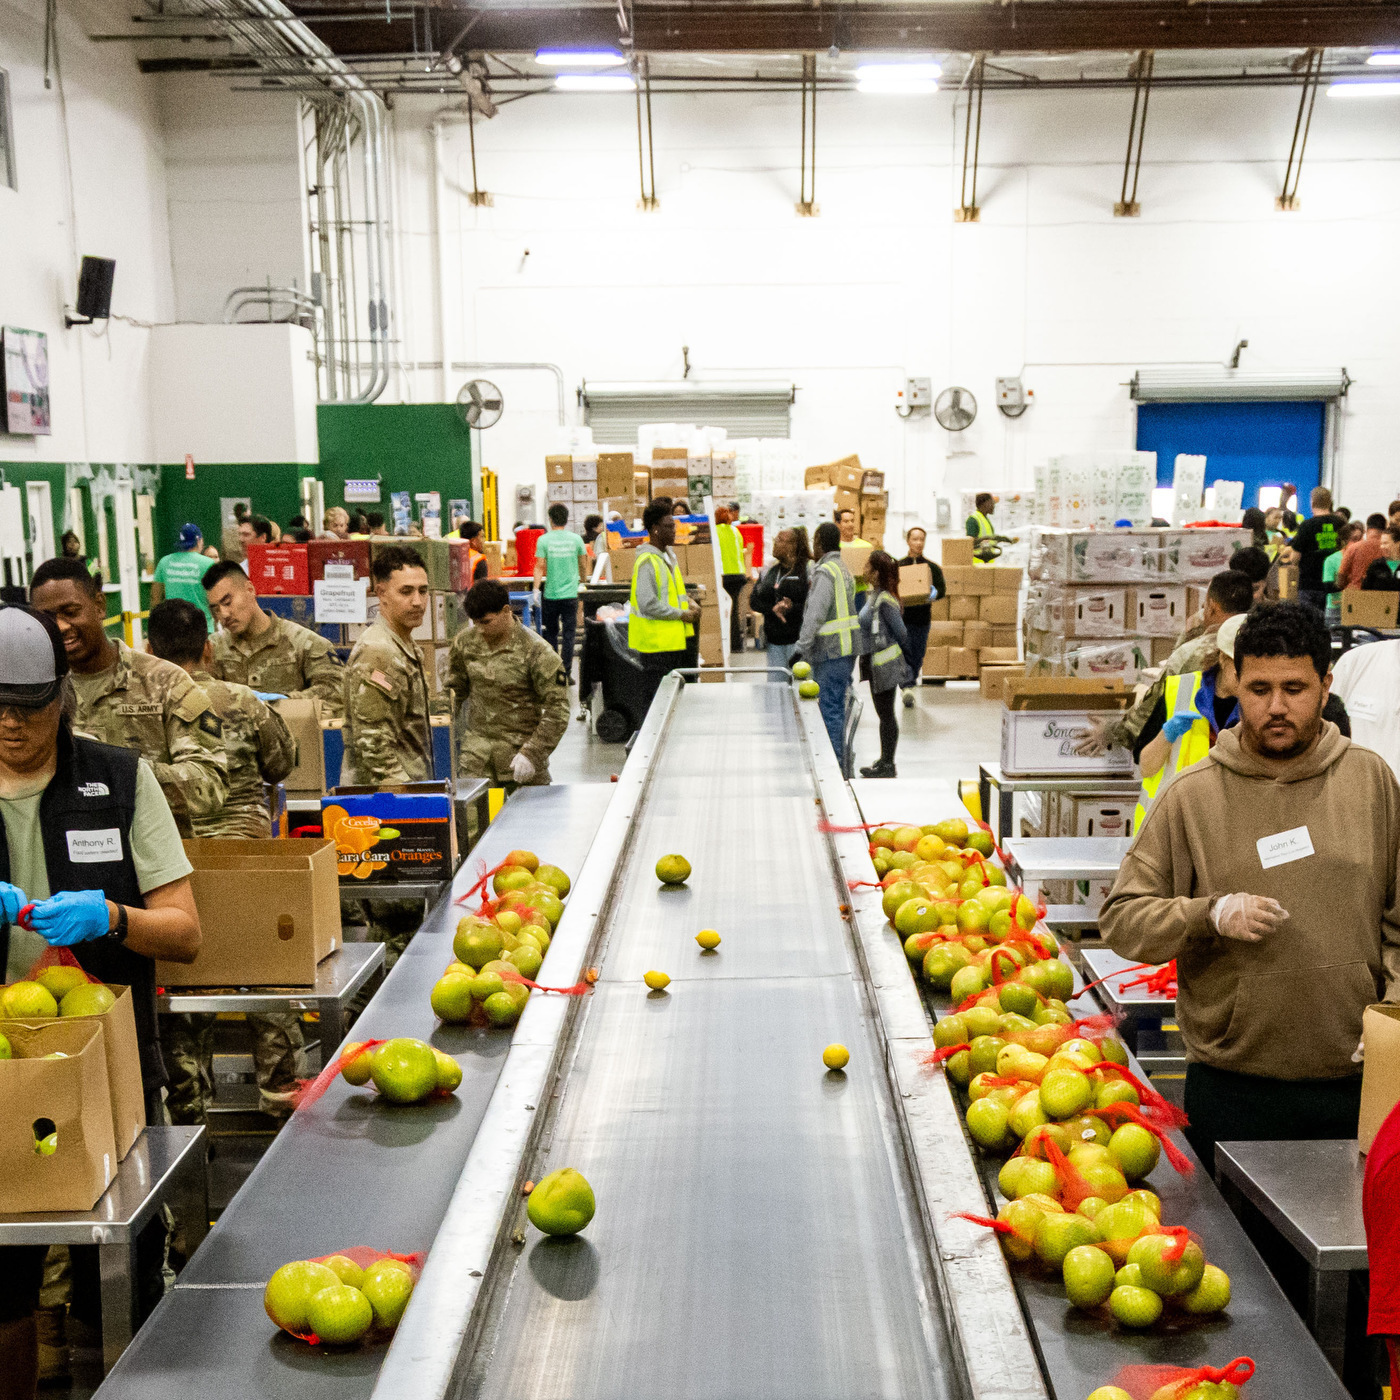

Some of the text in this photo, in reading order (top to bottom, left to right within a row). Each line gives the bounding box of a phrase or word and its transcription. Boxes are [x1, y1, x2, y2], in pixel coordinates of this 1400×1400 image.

[121, 704, 159, 713] U.S. ARMY
[348, 817, 378, 826] Cecelia
[72, 837, 117, 849] Anthony R.
[1268, 841, 1289, 853] John
[361, 850, 391, 862] Cara
[390, 849, 443, 863] Oranges
